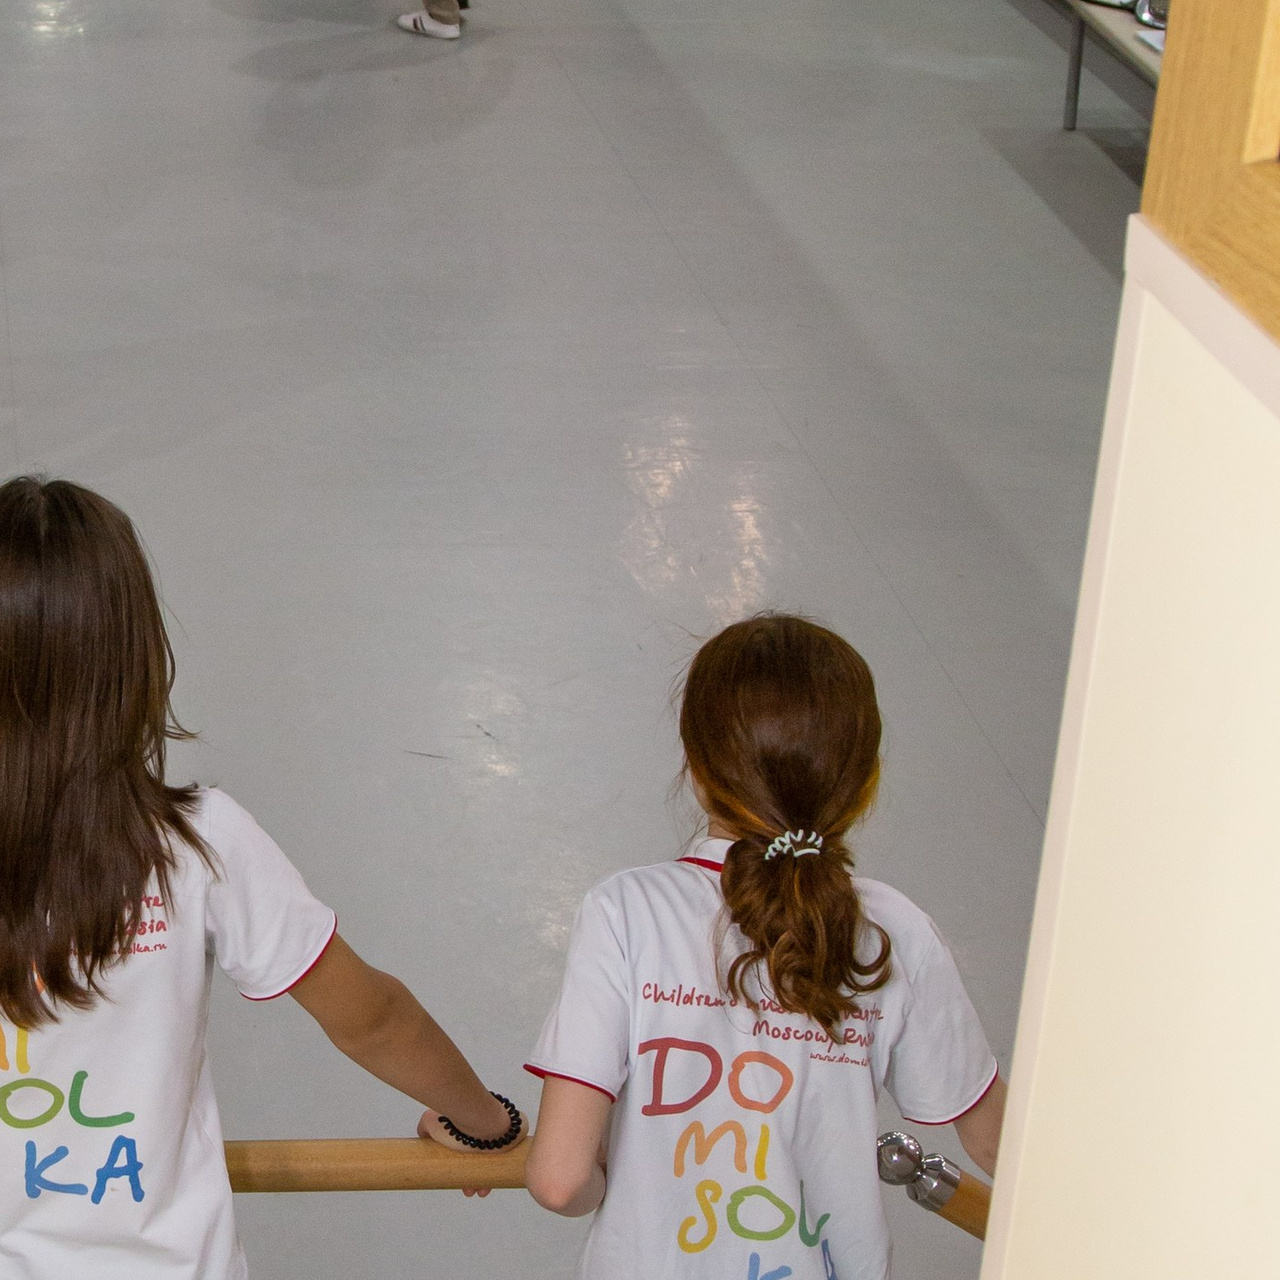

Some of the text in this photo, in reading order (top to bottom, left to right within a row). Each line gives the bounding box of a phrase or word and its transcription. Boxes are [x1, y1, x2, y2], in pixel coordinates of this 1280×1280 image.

[637, 1036, 794, 1116] DO
[24, 1134, 145, 1205] KA
[673, 1120, 770, 1181] MI
